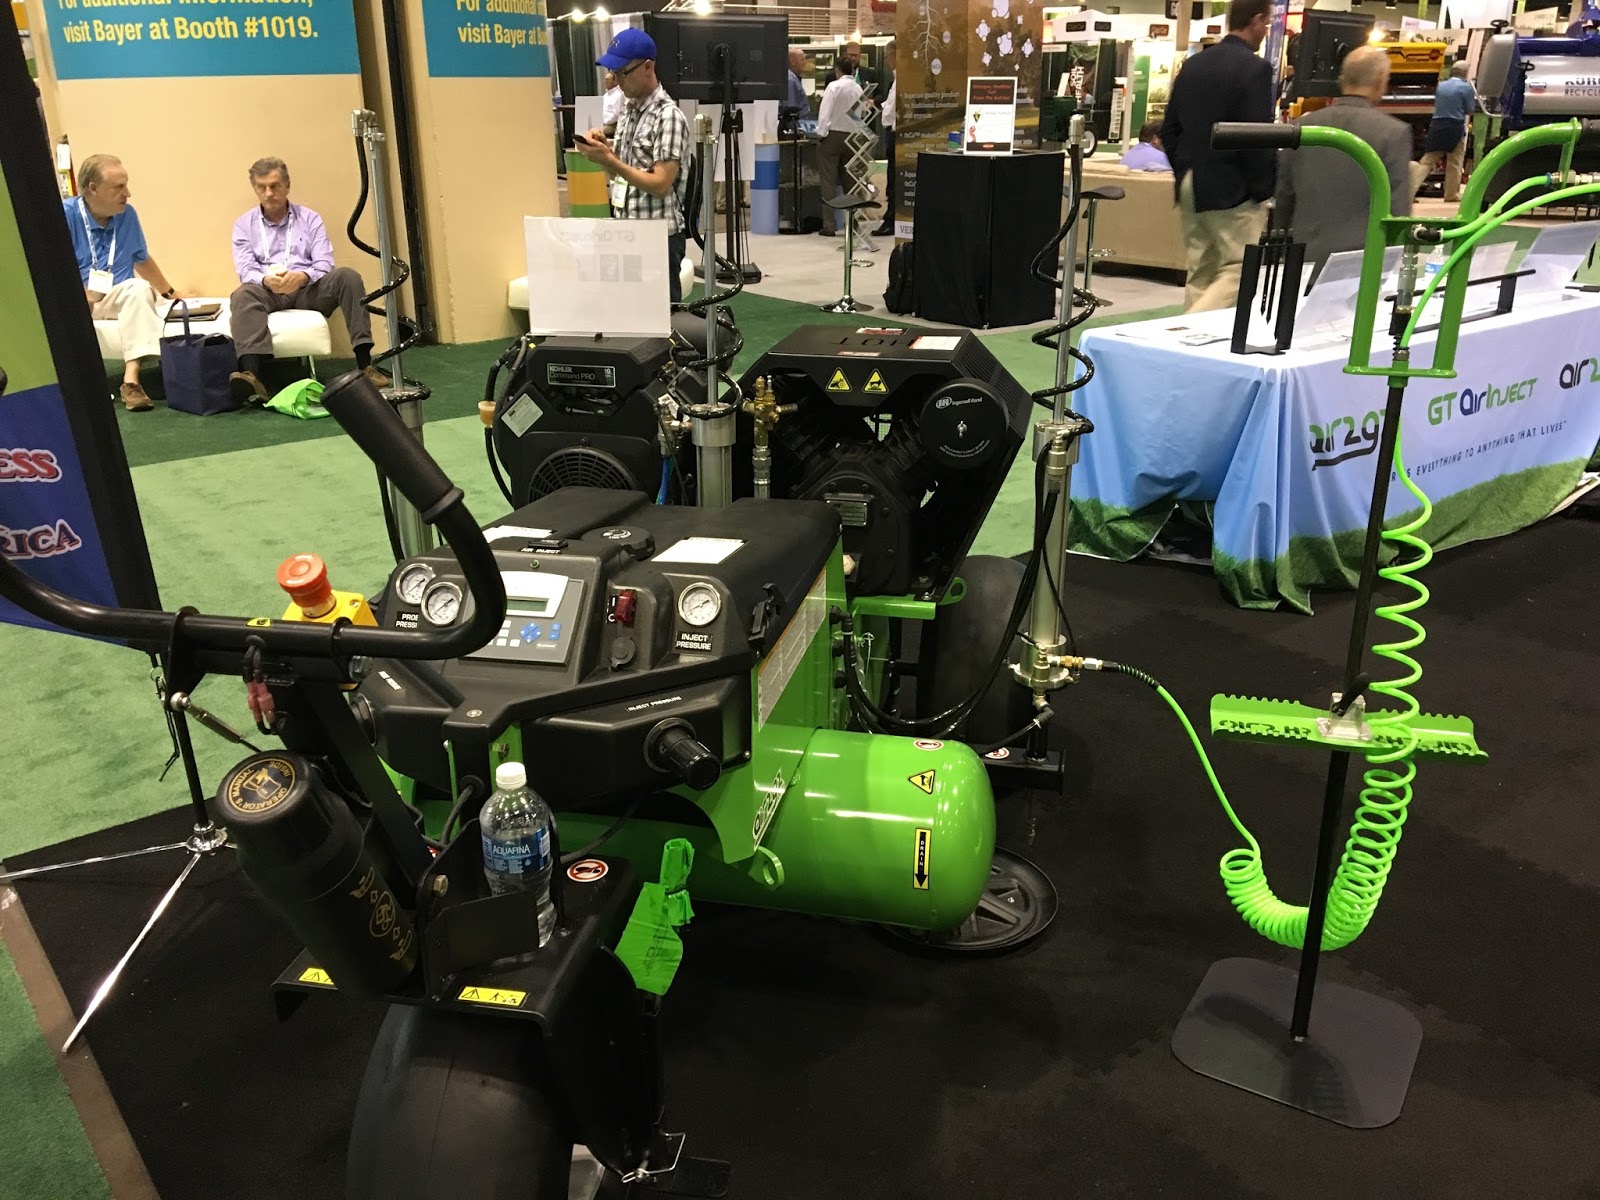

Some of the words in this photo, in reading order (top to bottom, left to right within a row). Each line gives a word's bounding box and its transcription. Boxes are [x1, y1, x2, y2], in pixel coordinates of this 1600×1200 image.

[63, 21, 92, 43] visit
[93, 19, 143, 46] Bayer
[149, 18, 171, 40] at
[174, 16, 239, 40] Booth
[244, 15, 319, 38] #1019.
[458, 22, 492, 43] visit
[494, 23, 526, 48] Bayer
[528, 27, 537, 45] at
[1070, 66, 1078, 86] SOIL
[1077, 66, 1085, 102] HEALTH
[549, 365, 573, 373] KOHLER
[550, 372, 580, 380] Command
[1428, 391, 1457, 426] GT
[1416, 448, 1463, 477] EVERYTHING
[1465, 448, 1475, 459] TO
[1477, 433, 1516, 455] ANYTHING
[676, 641, 712, 651] PRESSURE
[681, 633, 709, 642] INJECT
[627, 702, 650, 711] INJECT
[268, 761, 290, 777] INSIDE
[232, 769, 255, 797] MANUAL
[235, 787, 288, 810] OPERATOR'S
[493, 844, 531, 855] AQUAFINA
